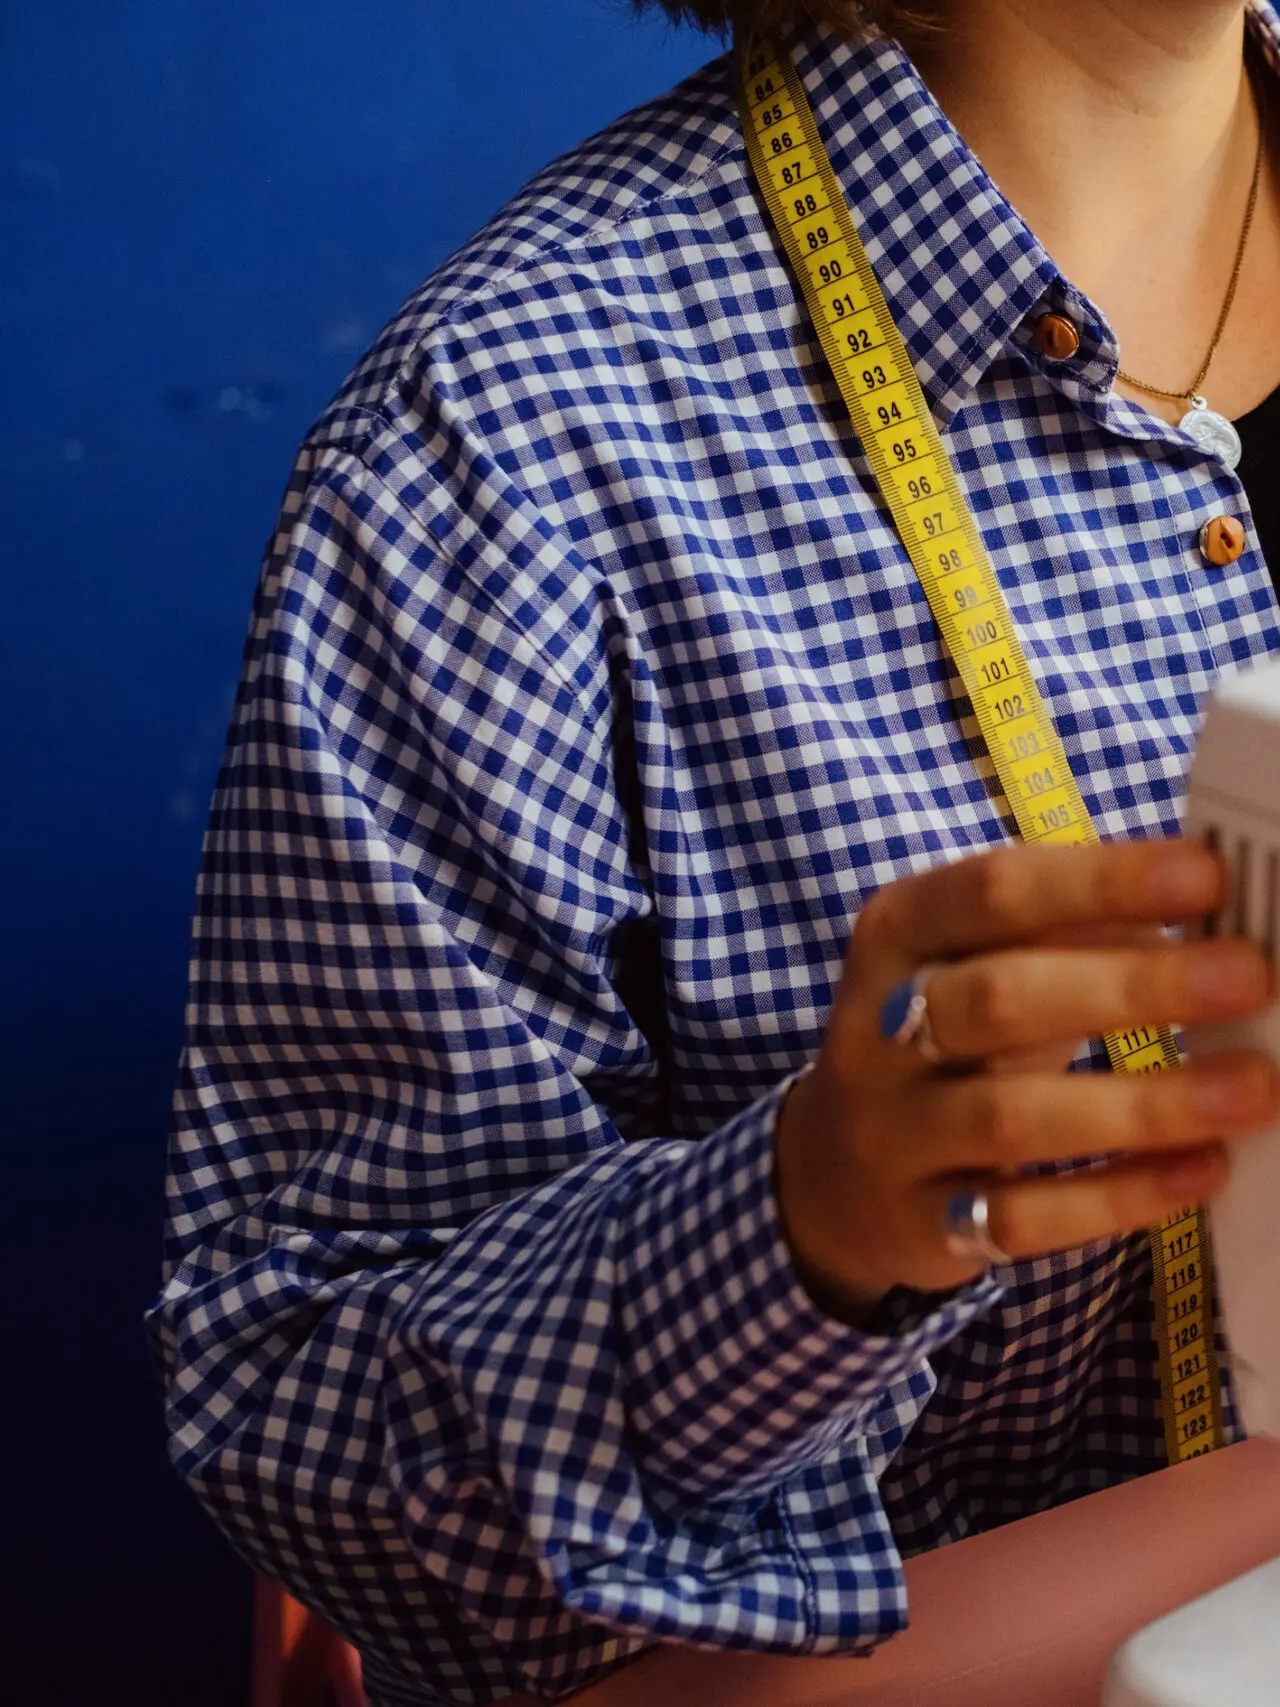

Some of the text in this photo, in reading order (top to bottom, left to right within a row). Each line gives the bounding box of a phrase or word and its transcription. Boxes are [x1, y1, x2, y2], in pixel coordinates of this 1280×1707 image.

[755, 78, 774, 100] 84
[762, 104, 783, 126] 85
[771, 132, 793, 153] 86
[781, 162, 802, 185] 87
[793, 194, 817, 217] 88
[806, 226, 829, 249] 89
[819, 260, 842, 283] 90
[832, 293, 855, 317] 91
[847, 328, 873, 353] 92
[862, 365, 887, 389] 93
[877, 401, 902, 425] 94
[893, 438, 917, 463] 95
[907, 475, 932, 499] 96
[923, 512, 945, 536] 97
[938, 549, 962, 572] 98
[966, 620, 997, 648] 100
[981, 657, 1010, 683] 101
[995, 694, 1026, 720] 102
[1008, 731, 1041, 758] 103
[1023, 767, 1055, 794] 104
[1038, 803, 1070, 831] 105
[1123, 1024, 1150, 1051] 111
[1168, 1231, 1193, 1257] 117
[1171, 1263, 1196, 1289] 118
[1173, 1294, 1197, 1319] 119
[1175, 1323, 1198, 1348] 120
[1177, 1353, 1200, 1379] 121
[1181, 1384, 1205, 1409] 122
[1183, 1414, 1207, 1440] 123
